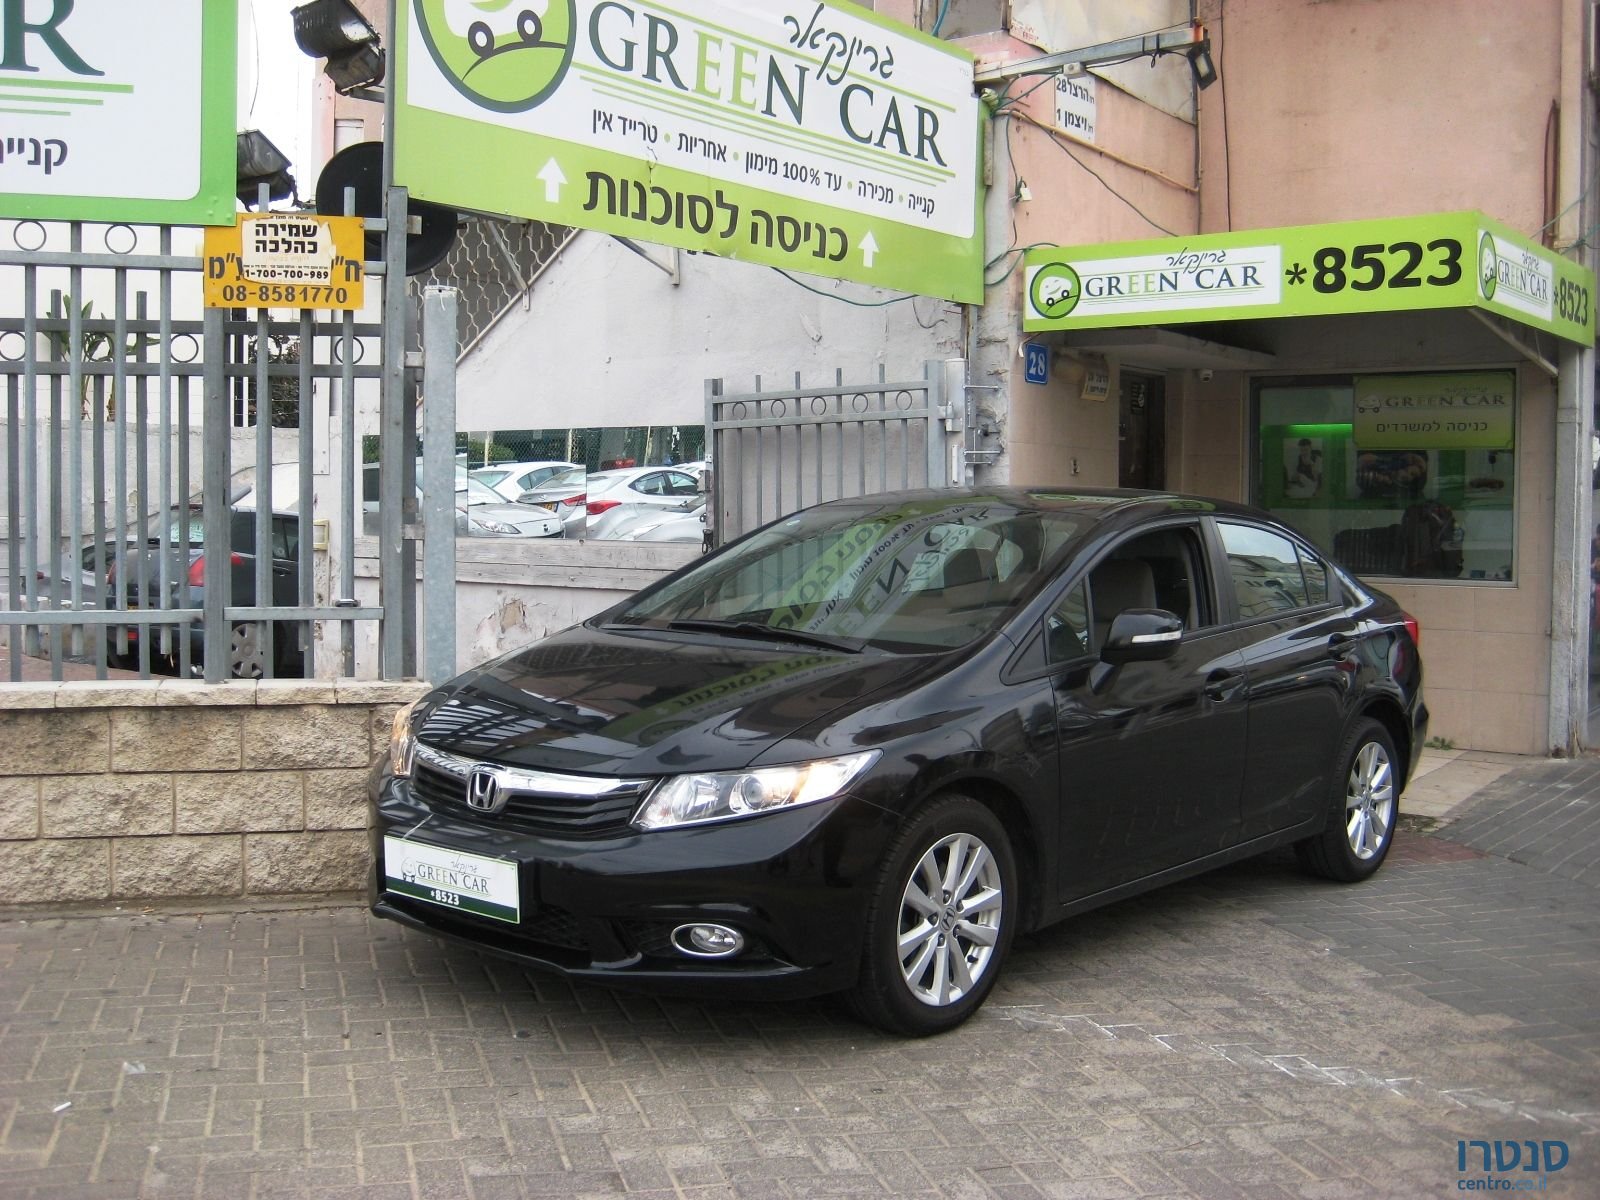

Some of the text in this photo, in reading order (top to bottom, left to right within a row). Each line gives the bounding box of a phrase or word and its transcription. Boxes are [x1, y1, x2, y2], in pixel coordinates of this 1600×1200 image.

[784, 3, 894, 85] גרינקאר
[588, 1, 947, 167] GREEN CAR
[1064, 110, 1087, 131] ויצמן
[593, 109, 935, 218] קנייה מכירה עד 100% מימון אחריות טרייד אין
[583, 171, 848, 262] כניסה לסוכנות
[255, 223, 317, 237] שמירה
[255, 238, 318, 254] כהלכה
[1166, 247, 1227, 274] גרינקאר
[245, 269, 329, 279] 1-700-700-989
[1085, 271, 1179, 297] GREEN
[1195, 265, 1262, 290] CAR
[1498, 259, 1527, 291] GREEN
[1530, 274, 1548, 300] CAR
[222, 284, 348, 304] 08-8581770
[1028, 351, 1045, 375] 28
[1385, 394, 1505, 407] GREEN CAR
[1376, 419, 1488, 433] כניסה למשרדים
[417, 864, 489, 893] GREEN CAR
